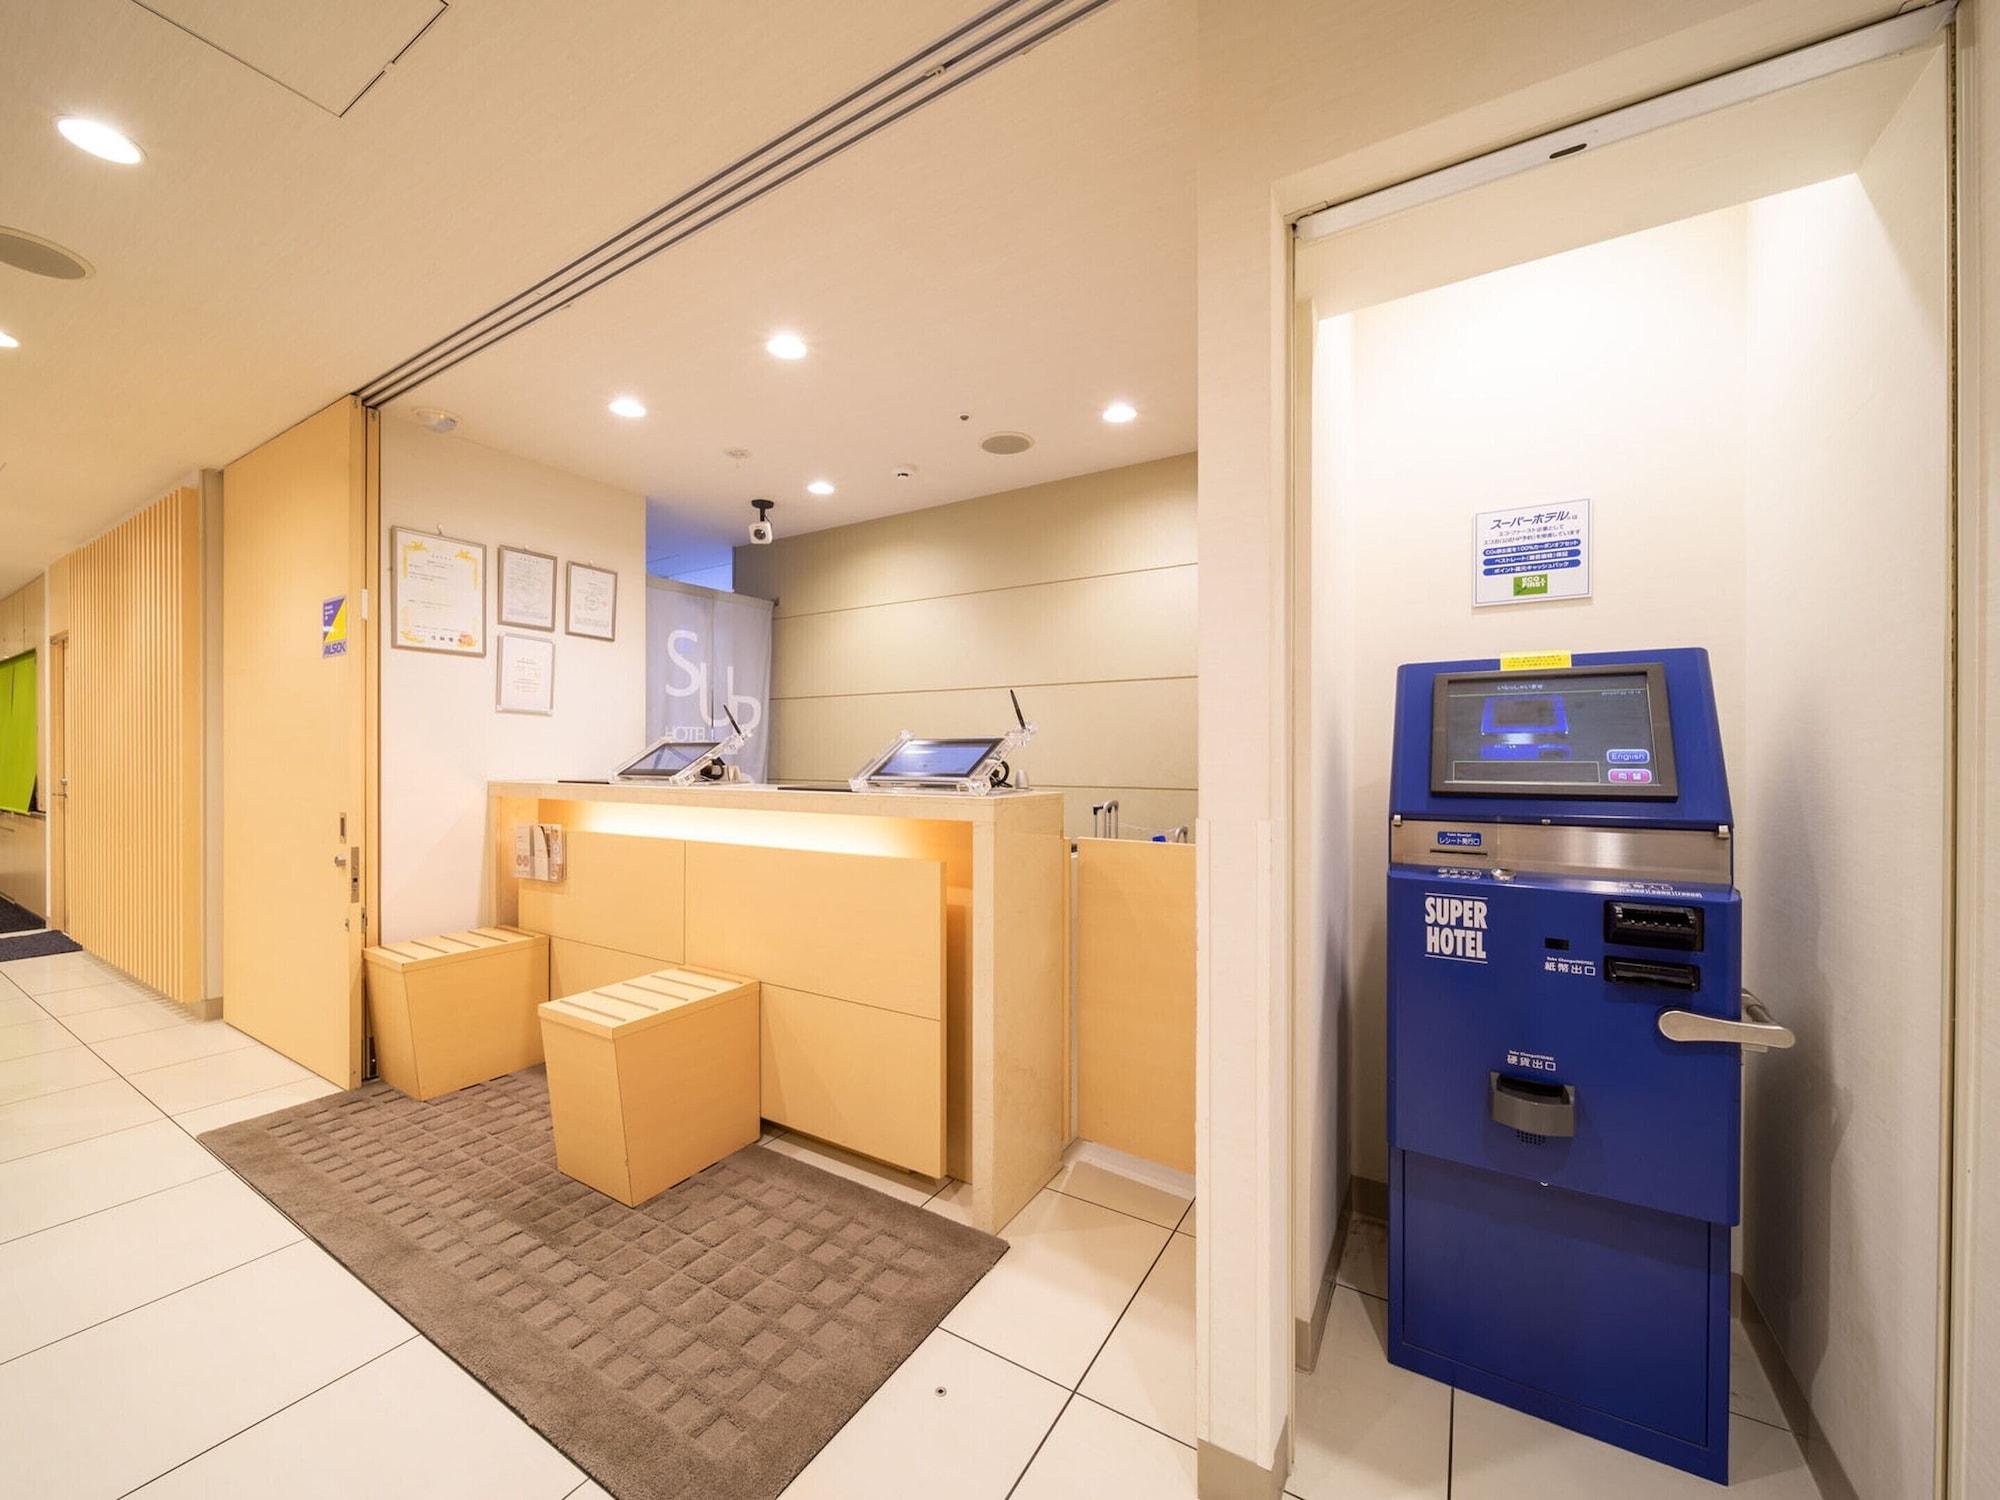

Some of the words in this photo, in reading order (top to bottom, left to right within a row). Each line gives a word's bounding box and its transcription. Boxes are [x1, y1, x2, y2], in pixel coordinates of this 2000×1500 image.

[1611, 752, 1646, 761] English
[1425, 897, 1488, 929] SUPER
[1426, 926, 1487, 959] HOTEL
[1544, 961, 1596, 976] 紙幣出口
[1507, 1054, 1556, 1071] 硬貨出口
